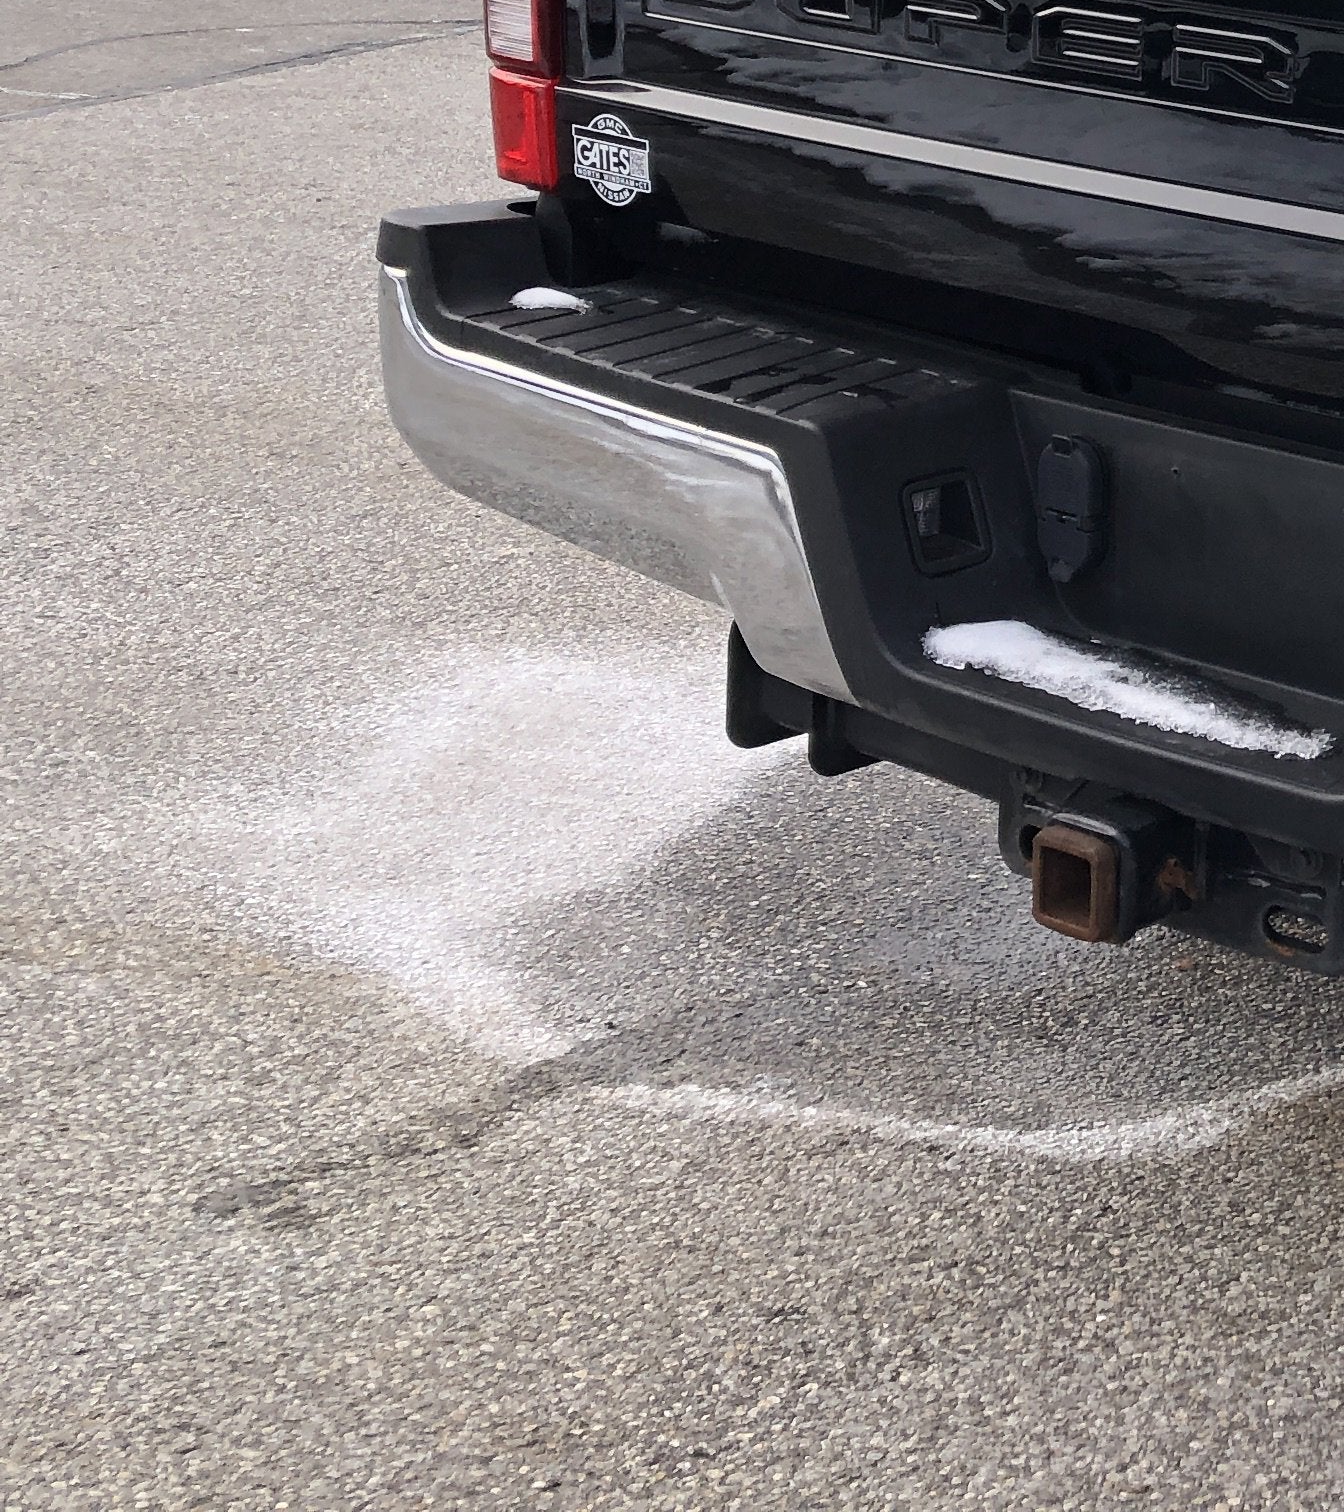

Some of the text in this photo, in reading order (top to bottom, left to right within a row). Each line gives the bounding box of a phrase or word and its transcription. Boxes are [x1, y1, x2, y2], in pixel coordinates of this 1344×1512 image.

[597, 118, 623, 133] GMC
[577, 139, 630, 176] GATES
[577, 167, 601, 179] NORTH
[597, 182, 630, 202] NISSAN
